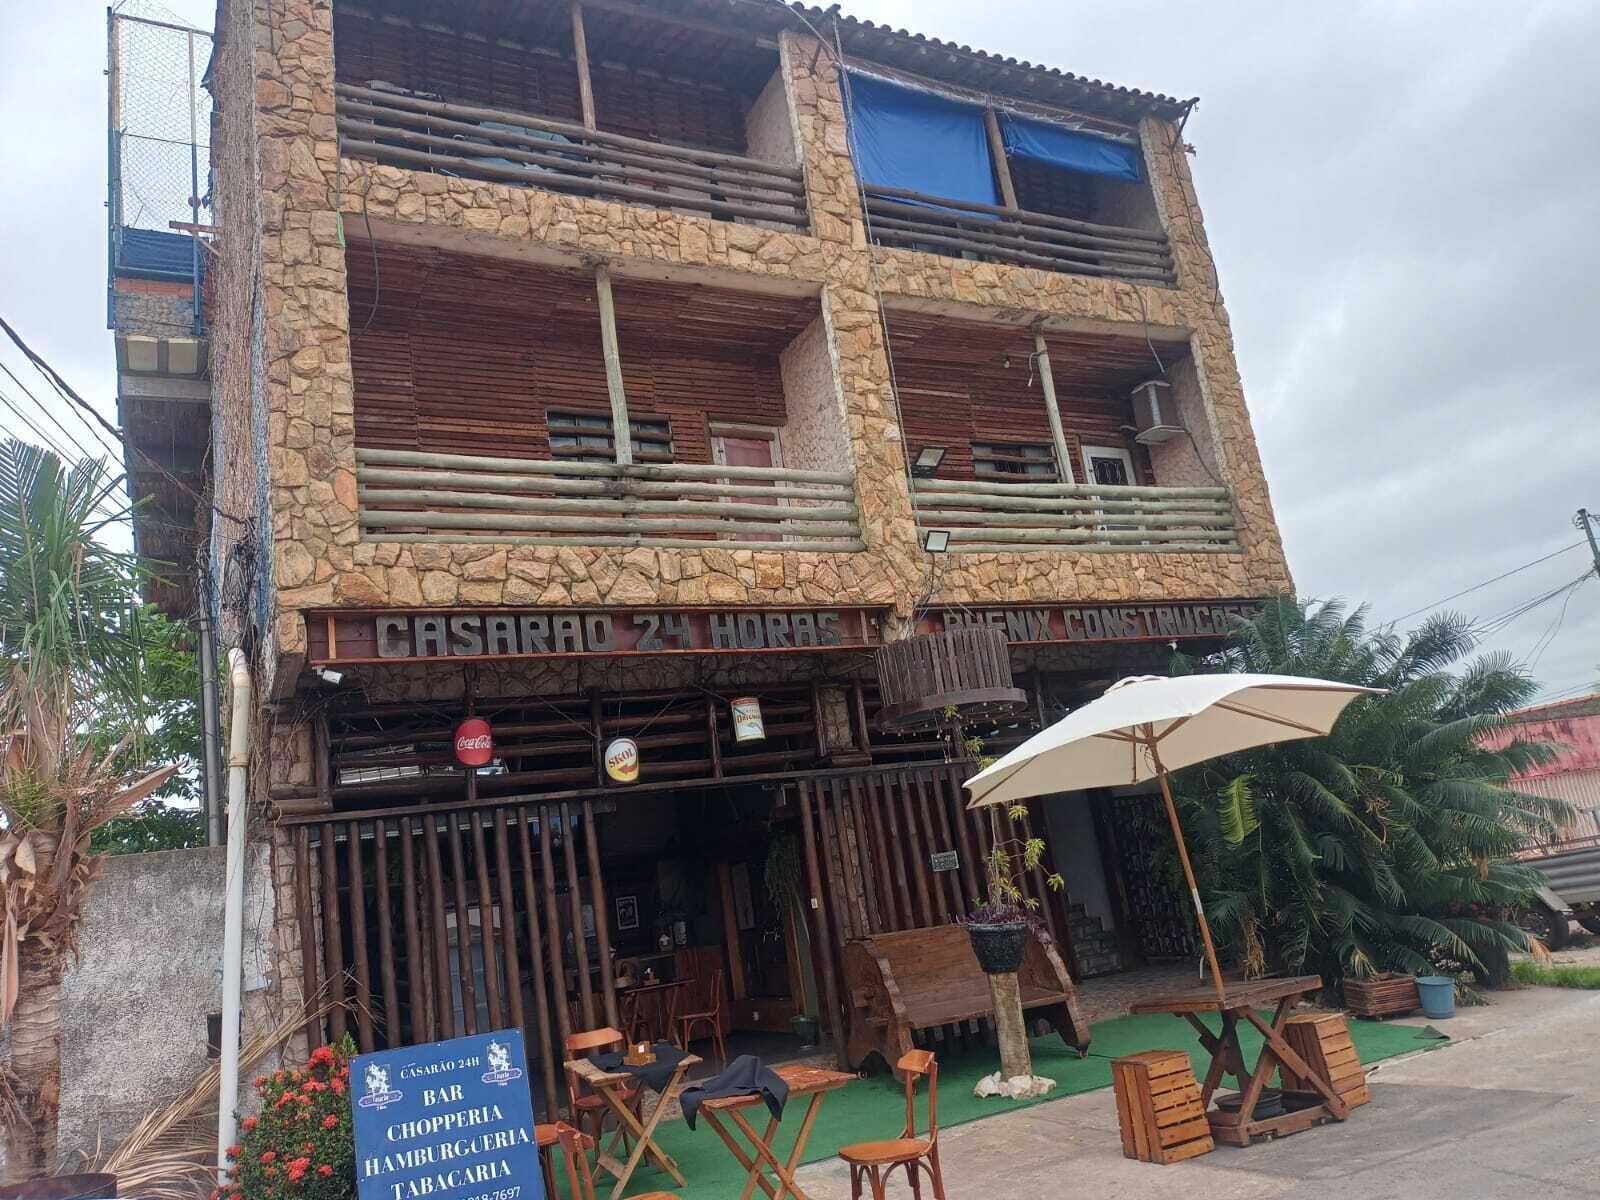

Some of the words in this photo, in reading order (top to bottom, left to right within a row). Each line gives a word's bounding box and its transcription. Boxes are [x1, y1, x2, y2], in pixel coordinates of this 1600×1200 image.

[632, 613, 690, 650] 24
[709, 612, 842, 649] HORAS
[608, 749, 634, 768] SKOL
[400, 1060, 455, 1079] CASARÃO
[458, 1056, 480, 1069] 24H
[423, 1084, 464, 1106] BAR
[387, 1104, 503, 1142] CHOPPERIA
[365, 1127, 529, 1177] HAMBURGUERIA
[391, 1159, 512, 1200] TABACARIA
